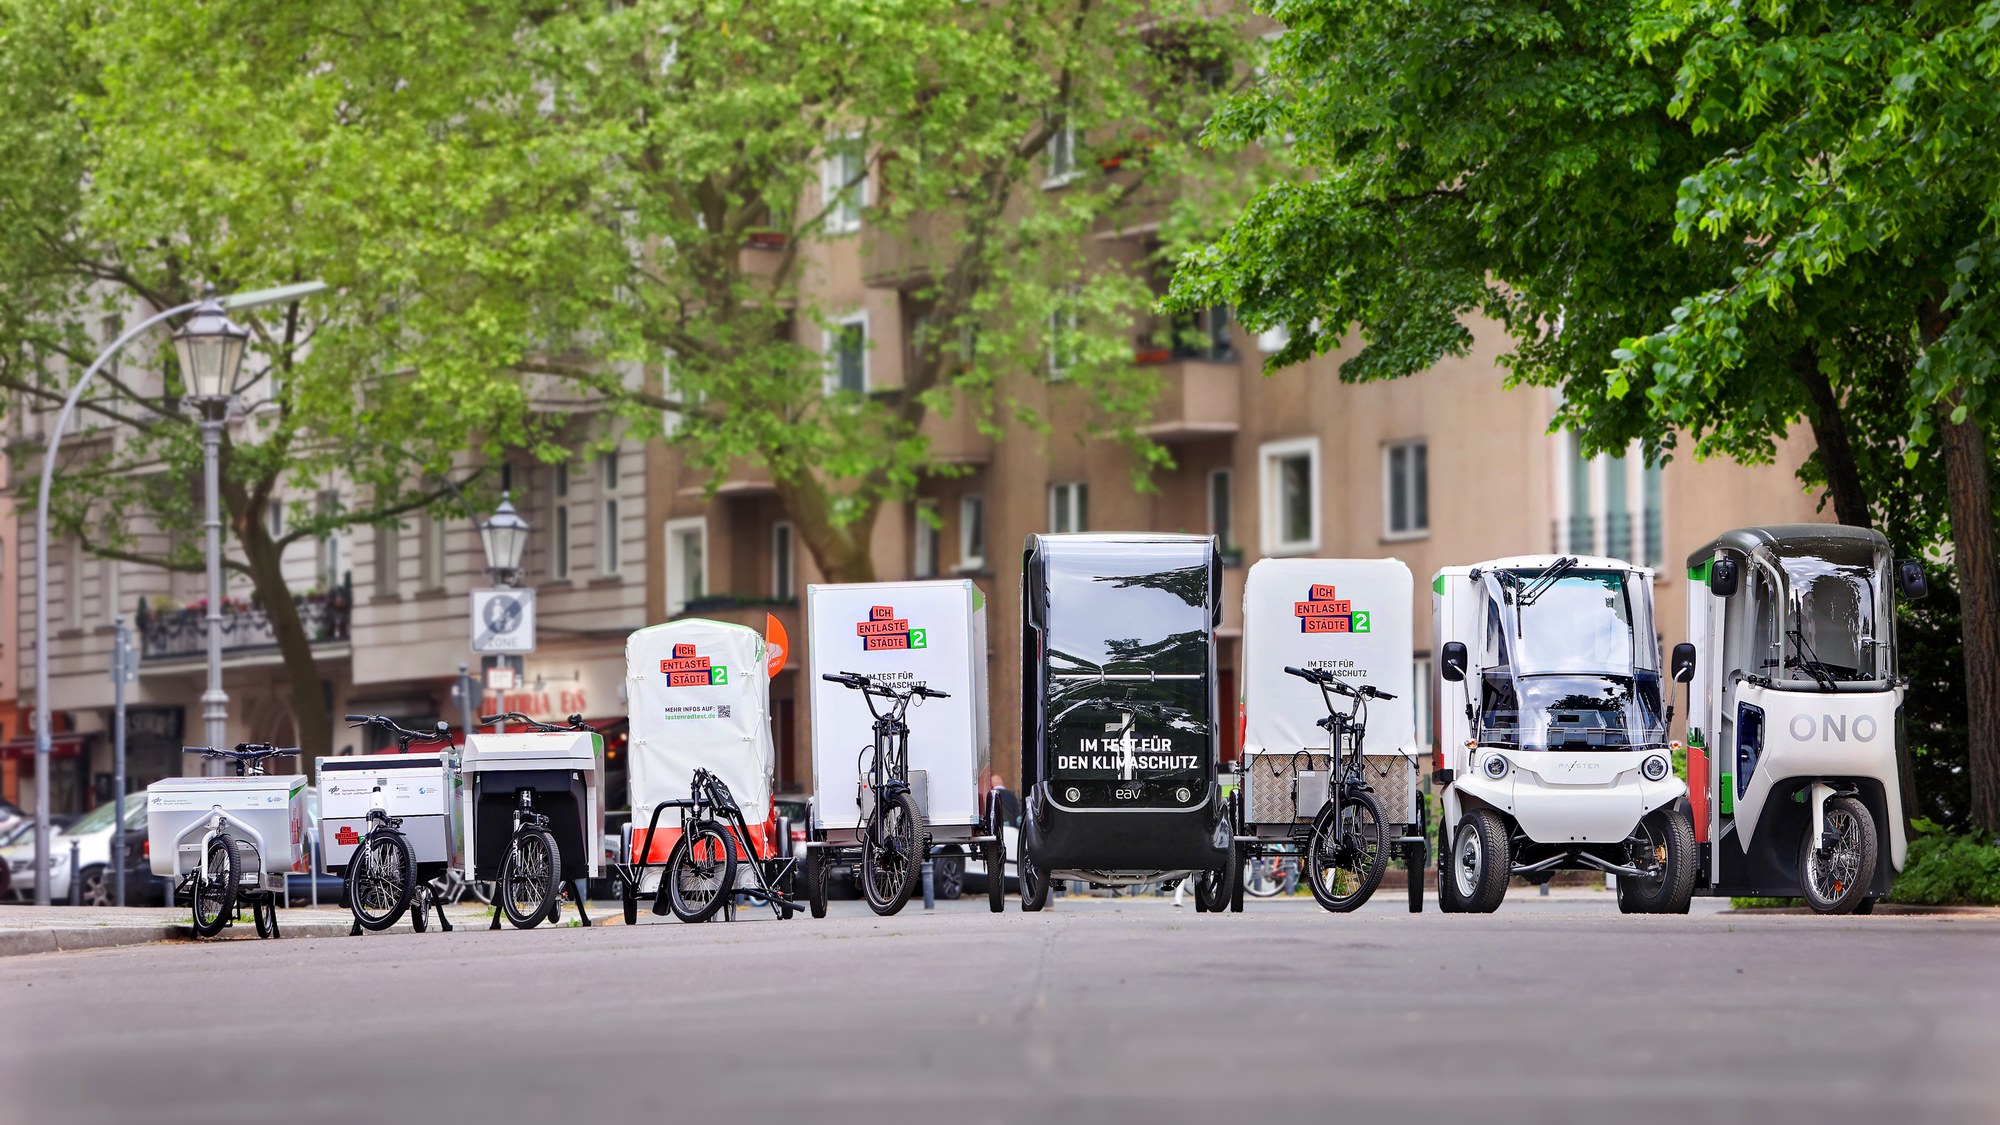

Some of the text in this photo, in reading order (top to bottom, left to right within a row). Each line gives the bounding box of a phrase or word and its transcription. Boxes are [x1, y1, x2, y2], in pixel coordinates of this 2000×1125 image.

[1316, 587, 1332, 597] ICH
[875, 608, 891, 617] ICH
[1297, 603, 1348, 614] ENTLASTE
[859, 622, 906, 634] ENTLASTE
[1308, 618, 1345, 630] STÄDTE
[1355, 613, 1368, 631] 2
[487, 636, 519, 648] ZONE
[870, 637, 904, 648] STÄDTE
[912, 630, 925, 647] 2
[678, 646, 694, 655] ICH
[662, 659, 708, 670] ENTLASTE
[1307, 659, 1354, 668] IM TEST FÜR
[673, 673, 706, 685] STÄDTE
[714, 667, 726, 683] 2
[877, 672, 896, 681] TEST
[897, 671, 914, 680] FÜR
[1789, 713, 1877, 742] ONO
[1080, 735, 1172, 752] IM TEST FÜR
[1058, 755, 1198, 770] DEN KLIMASCHUTZ
[1115, 788, 1141, 800] eav
